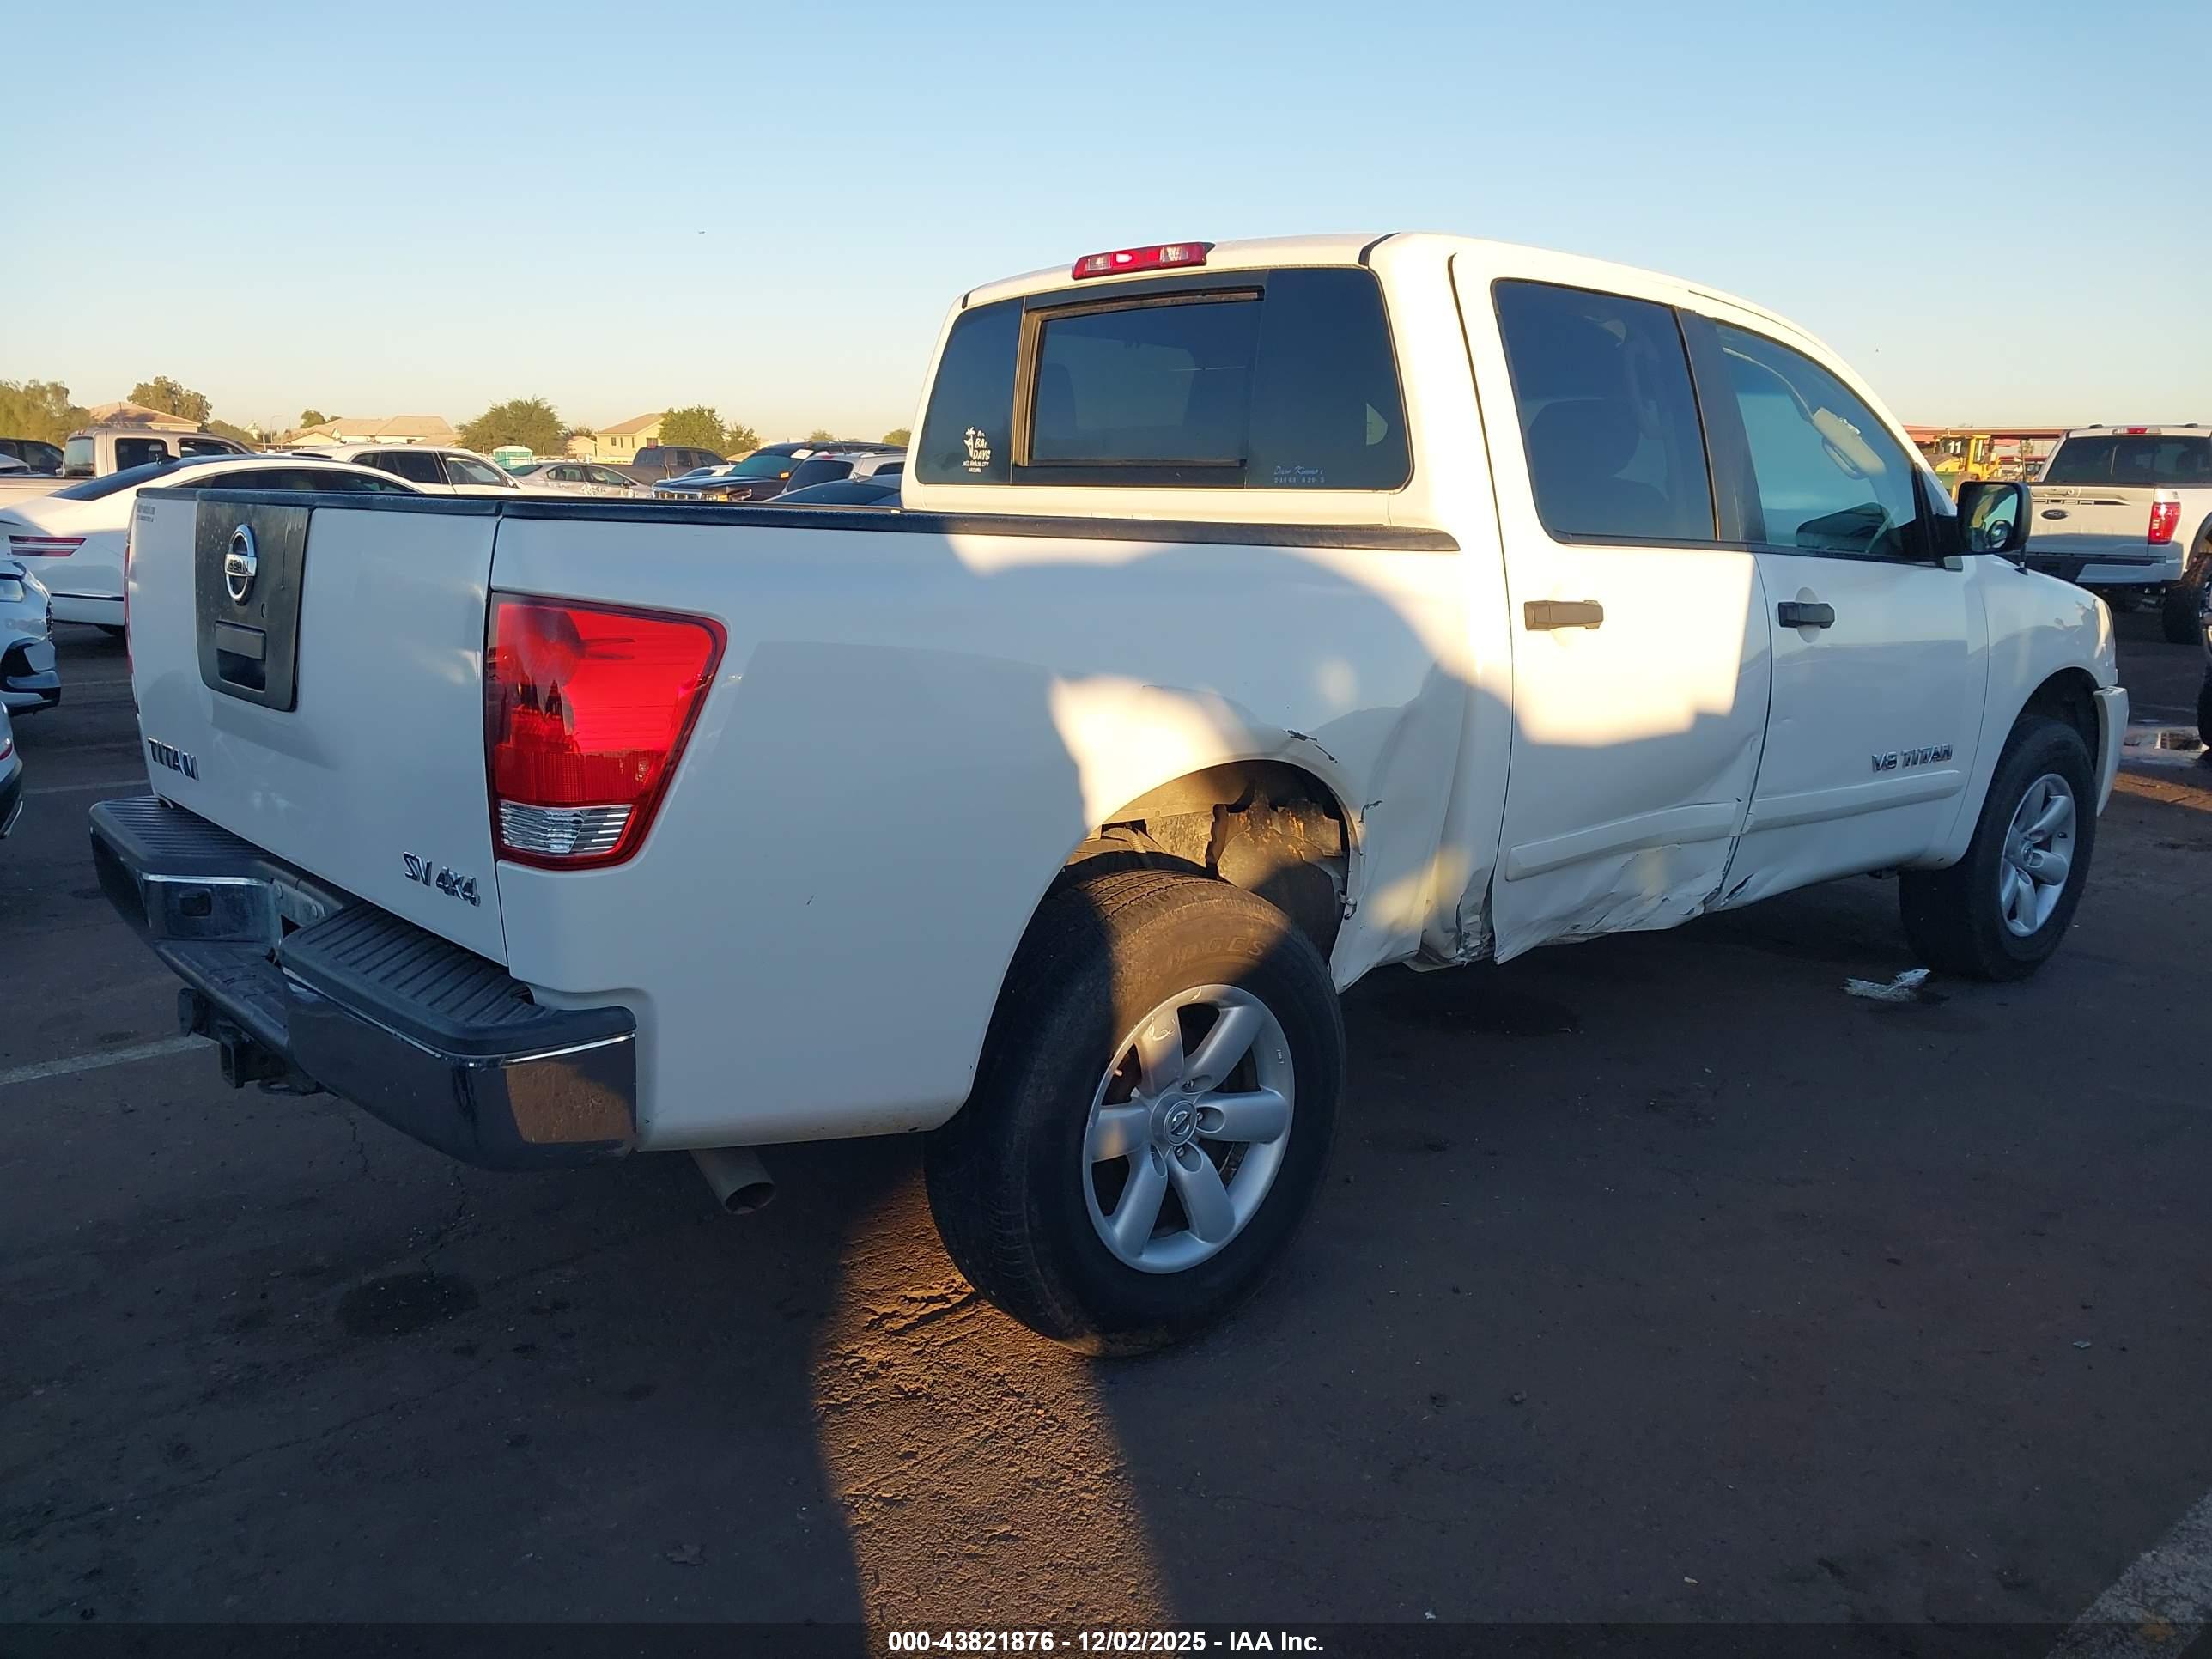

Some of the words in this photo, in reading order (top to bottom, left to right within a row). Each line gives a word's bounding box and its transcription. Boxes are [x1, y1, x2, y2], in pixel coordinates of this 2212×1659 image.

[1948, 441, 1962, 454] 11
[147, 737, 200, 781] TITAN
[1901, 744, 1954, 768] TITAN
[403, 851, 433, 887] SV
